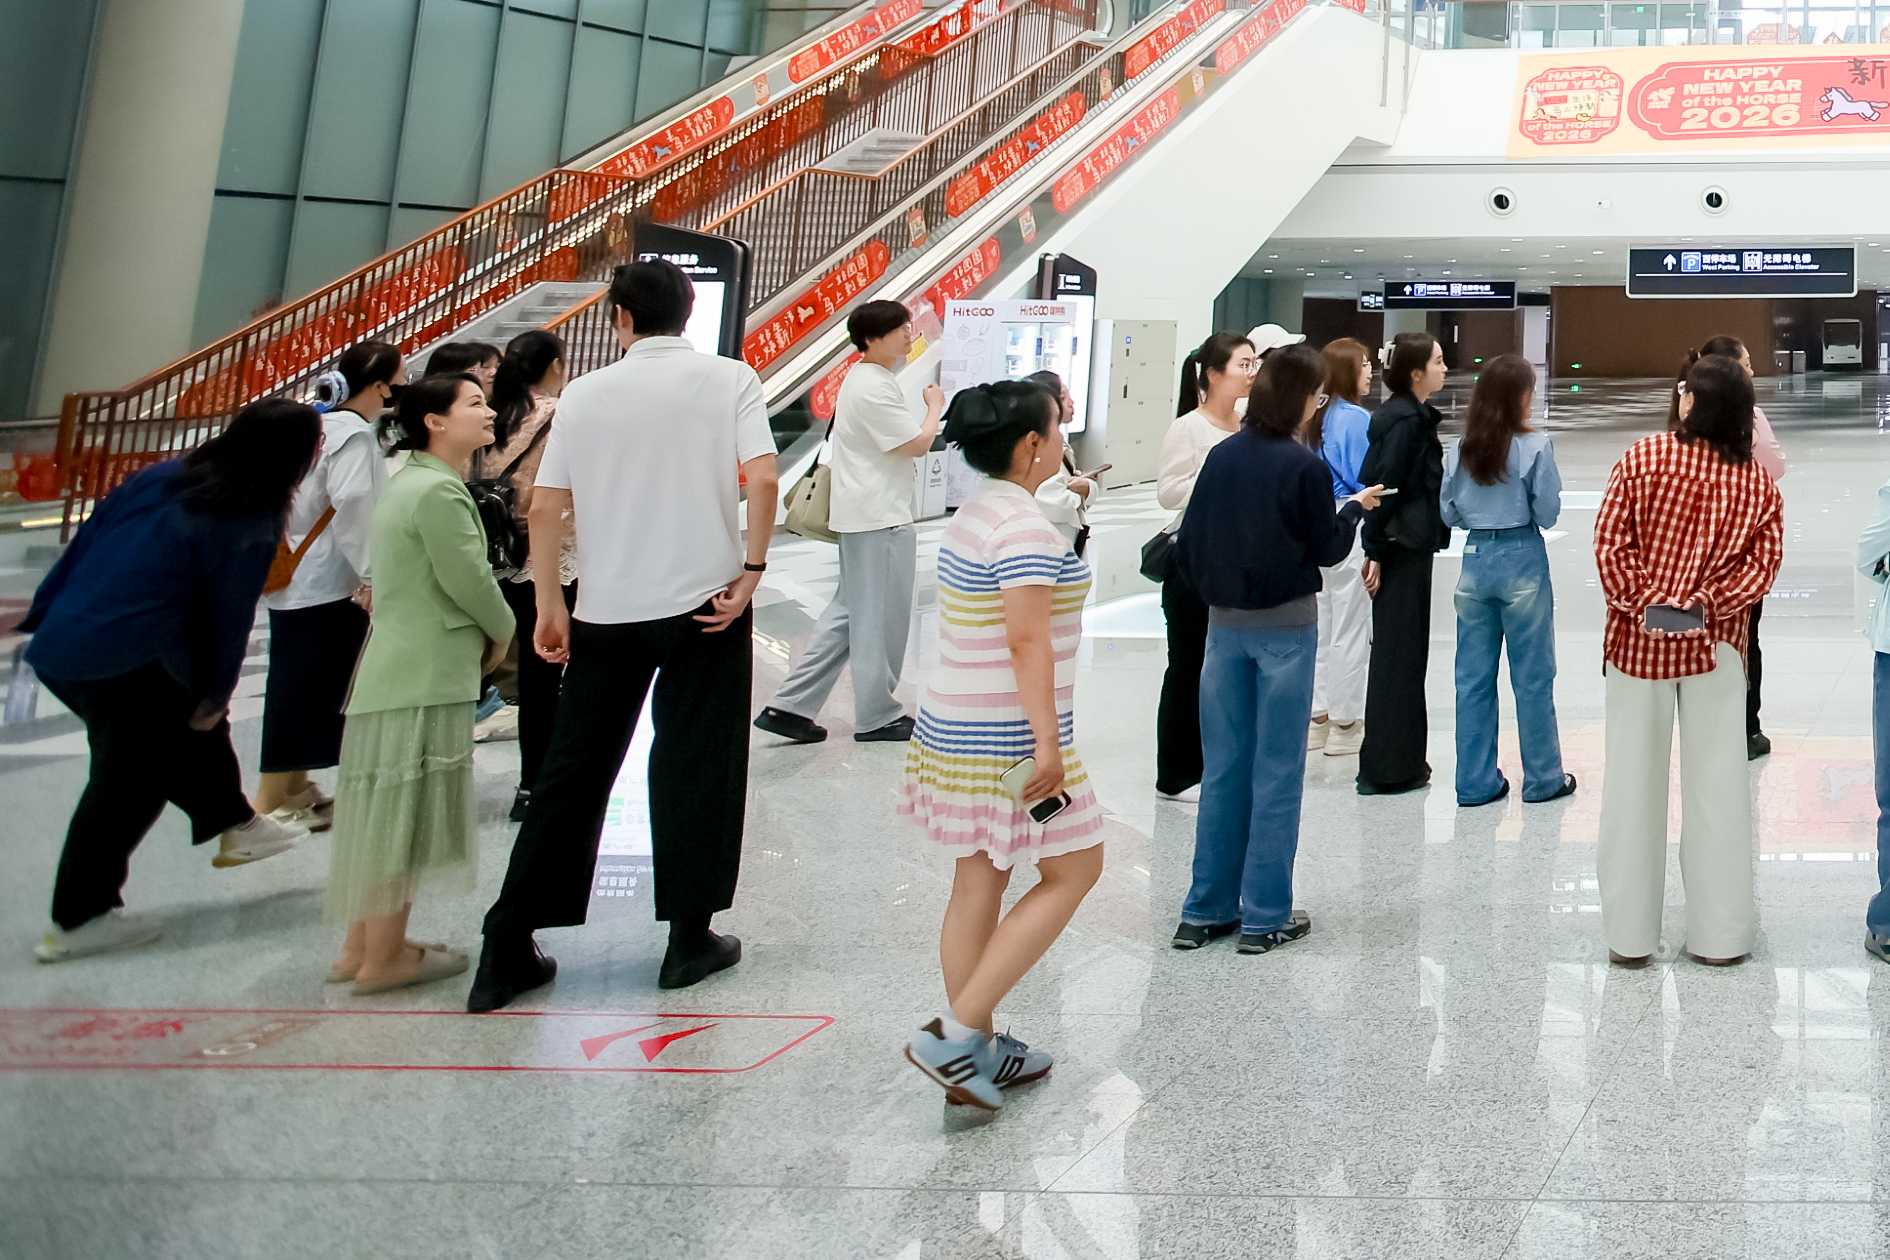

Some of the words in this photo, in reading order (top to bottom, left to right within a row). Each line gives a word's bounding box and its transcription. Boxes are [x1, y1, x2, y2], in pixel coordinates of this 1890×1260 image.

[1547, 71, 1603, 81] HAPPY
[1703, 66, 1784, 81] HAPPY
[1533, 81, 1570, 91] NEW
[1572, 80, 1616, 89] YEAR
[1683, 81, 1735, 96] NEW
[1738, 79, 1803, 93] YEAR
[1681, 97, 1700, 108] of
[1703, 96, 1733, 107] the
[1736, 93, 1802, 105] HORSE
[1680, 104, 1801, 130] 2026
[1528, 123, 1541, 131] of
[1543, 122, 1563, 130] the
[1565, 121, 1612, 129] HORSE
[1543, 130, 1592, 140] 2026
[1702, 254, 1737, 264] 西停车场
[953, 307, 995, 317] HitGOO
[748, 311, 794, 349] 一站生活
